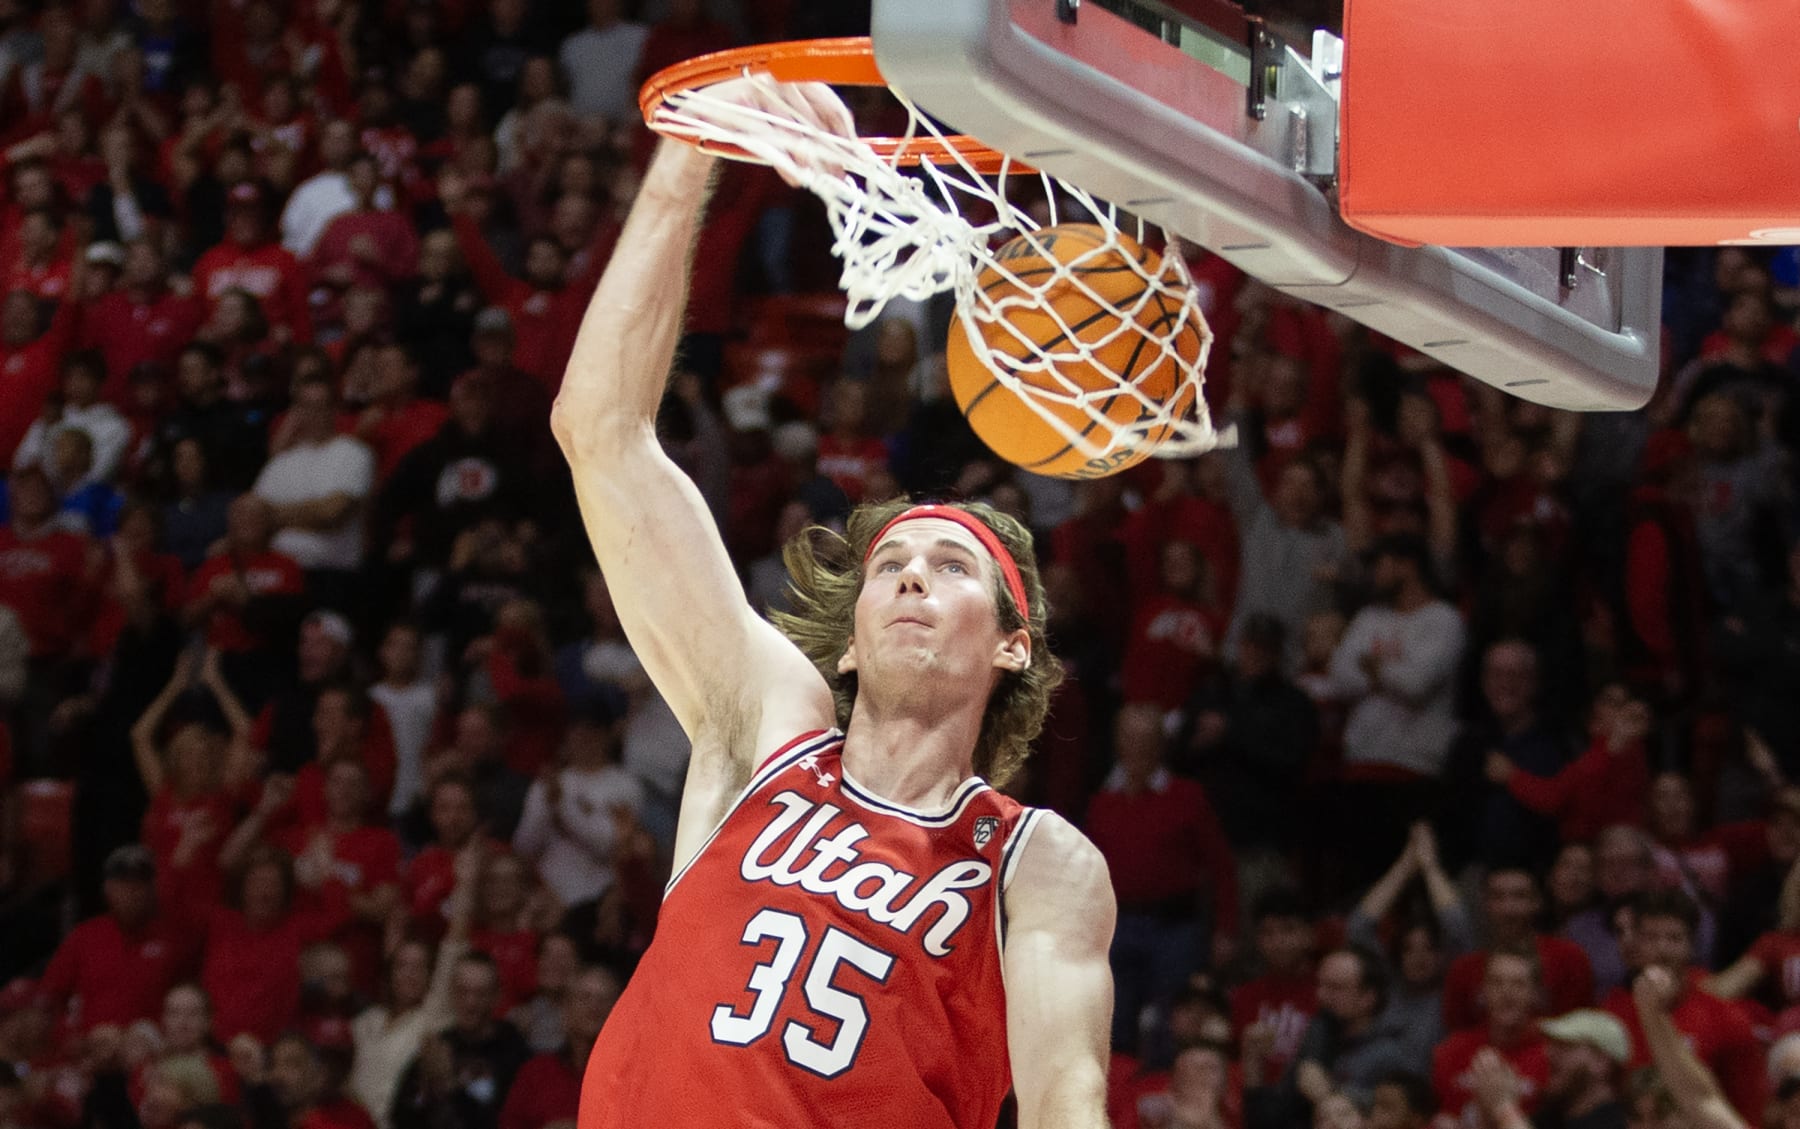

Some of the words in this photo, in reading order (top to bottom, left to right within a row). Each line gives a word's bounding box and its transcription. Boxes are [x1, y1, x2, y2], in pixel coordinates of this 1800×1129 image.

[740, 789, 992, 957] Utah
[975, 831, 989, 844] 12
[709, 907, 897, 1080] 35
